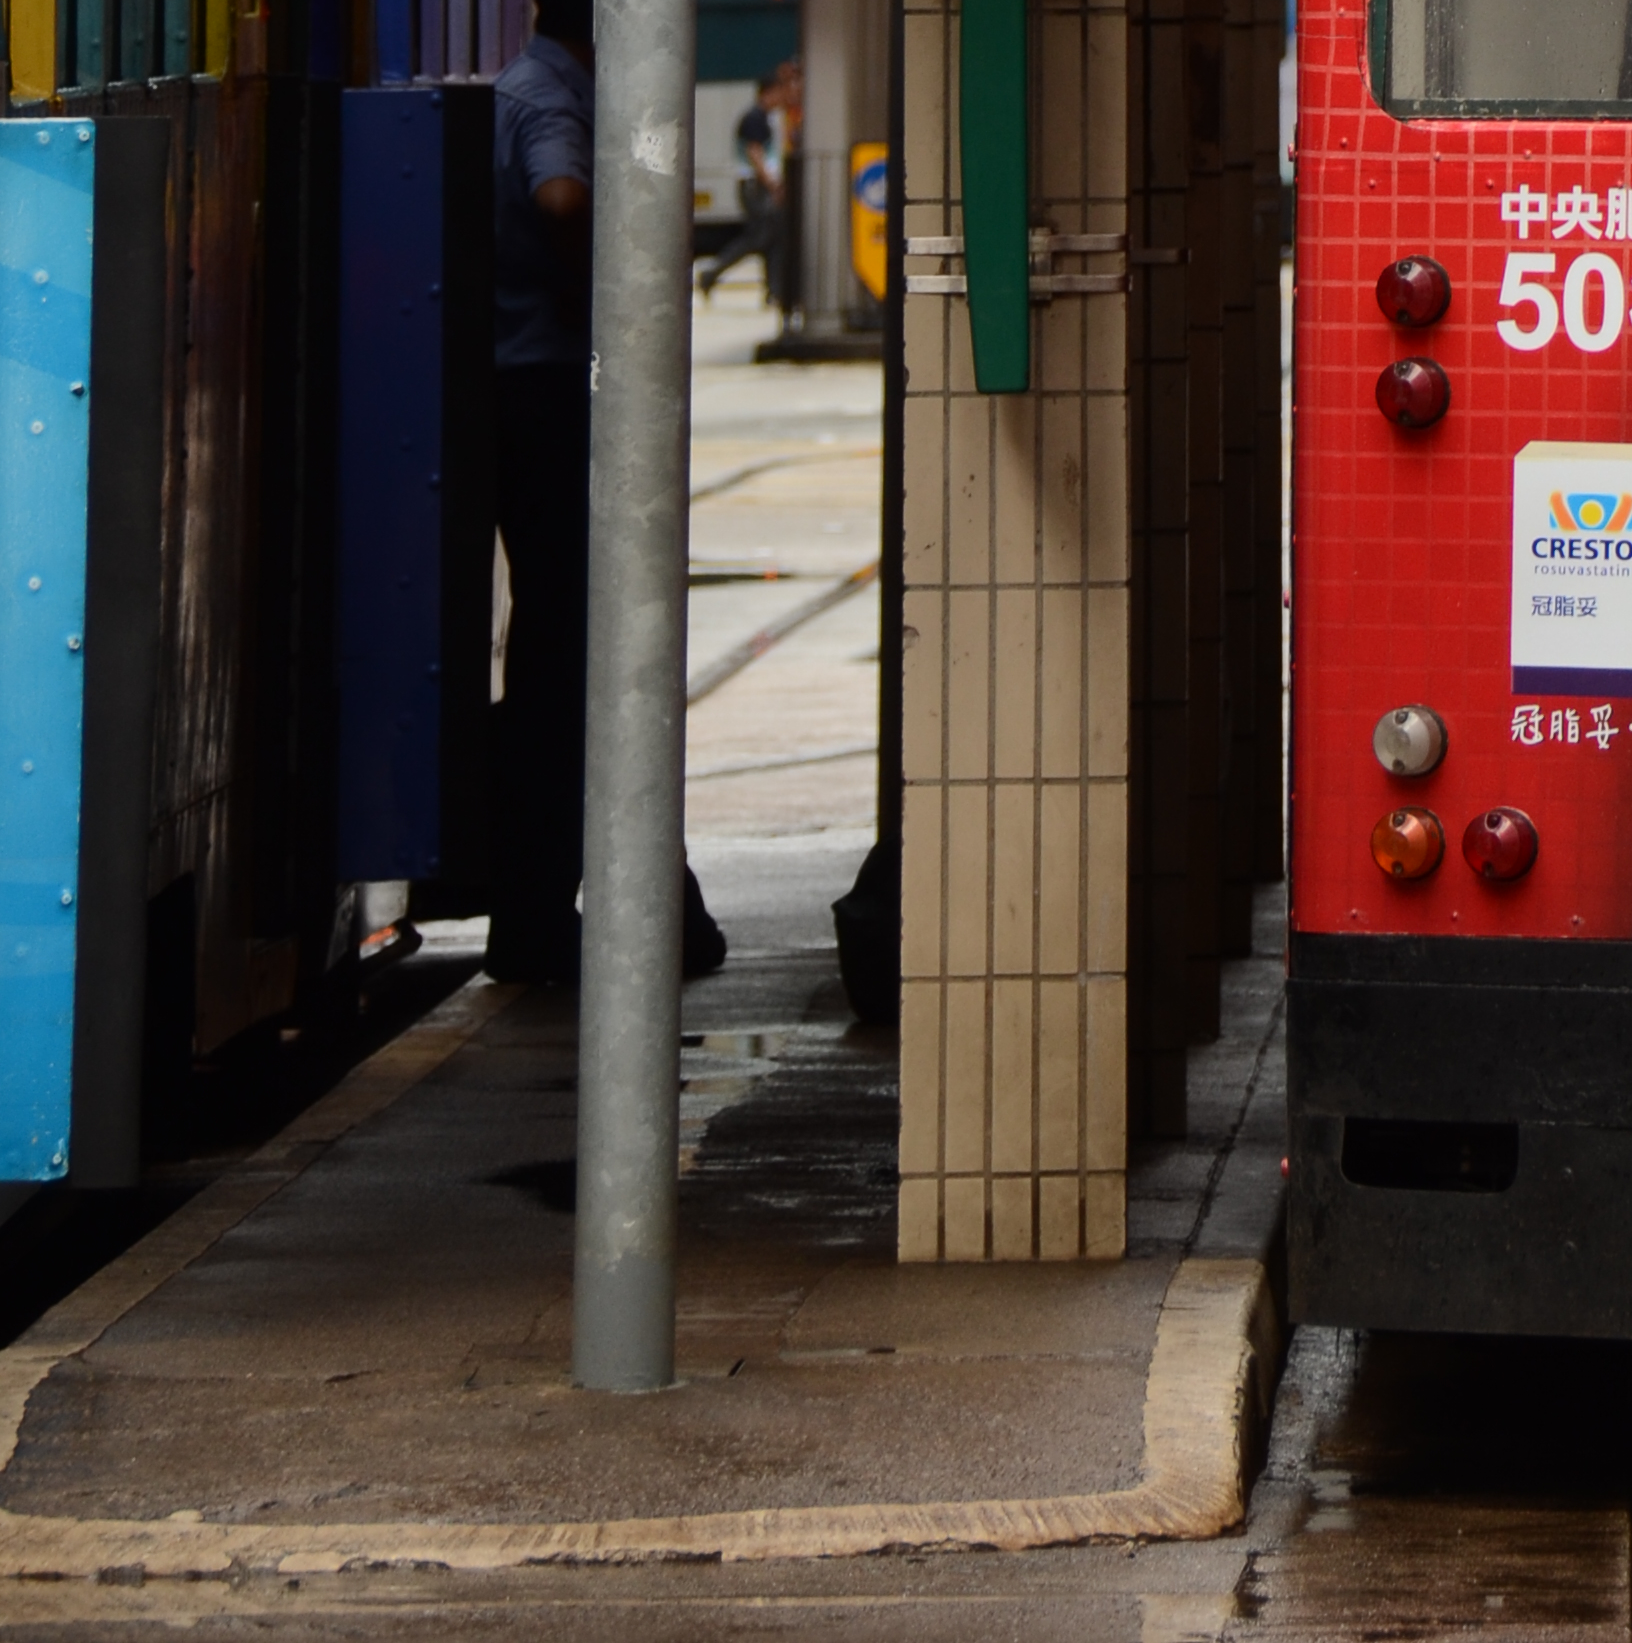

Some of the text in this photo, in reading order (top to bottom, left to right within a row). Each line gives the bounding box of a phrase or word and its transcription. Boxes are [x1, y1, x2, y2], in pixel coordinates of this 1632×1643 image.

[1534, 563, 1632, 578] rosuvastatin
[1530, 595, 1599, 619] 冠脂妥
